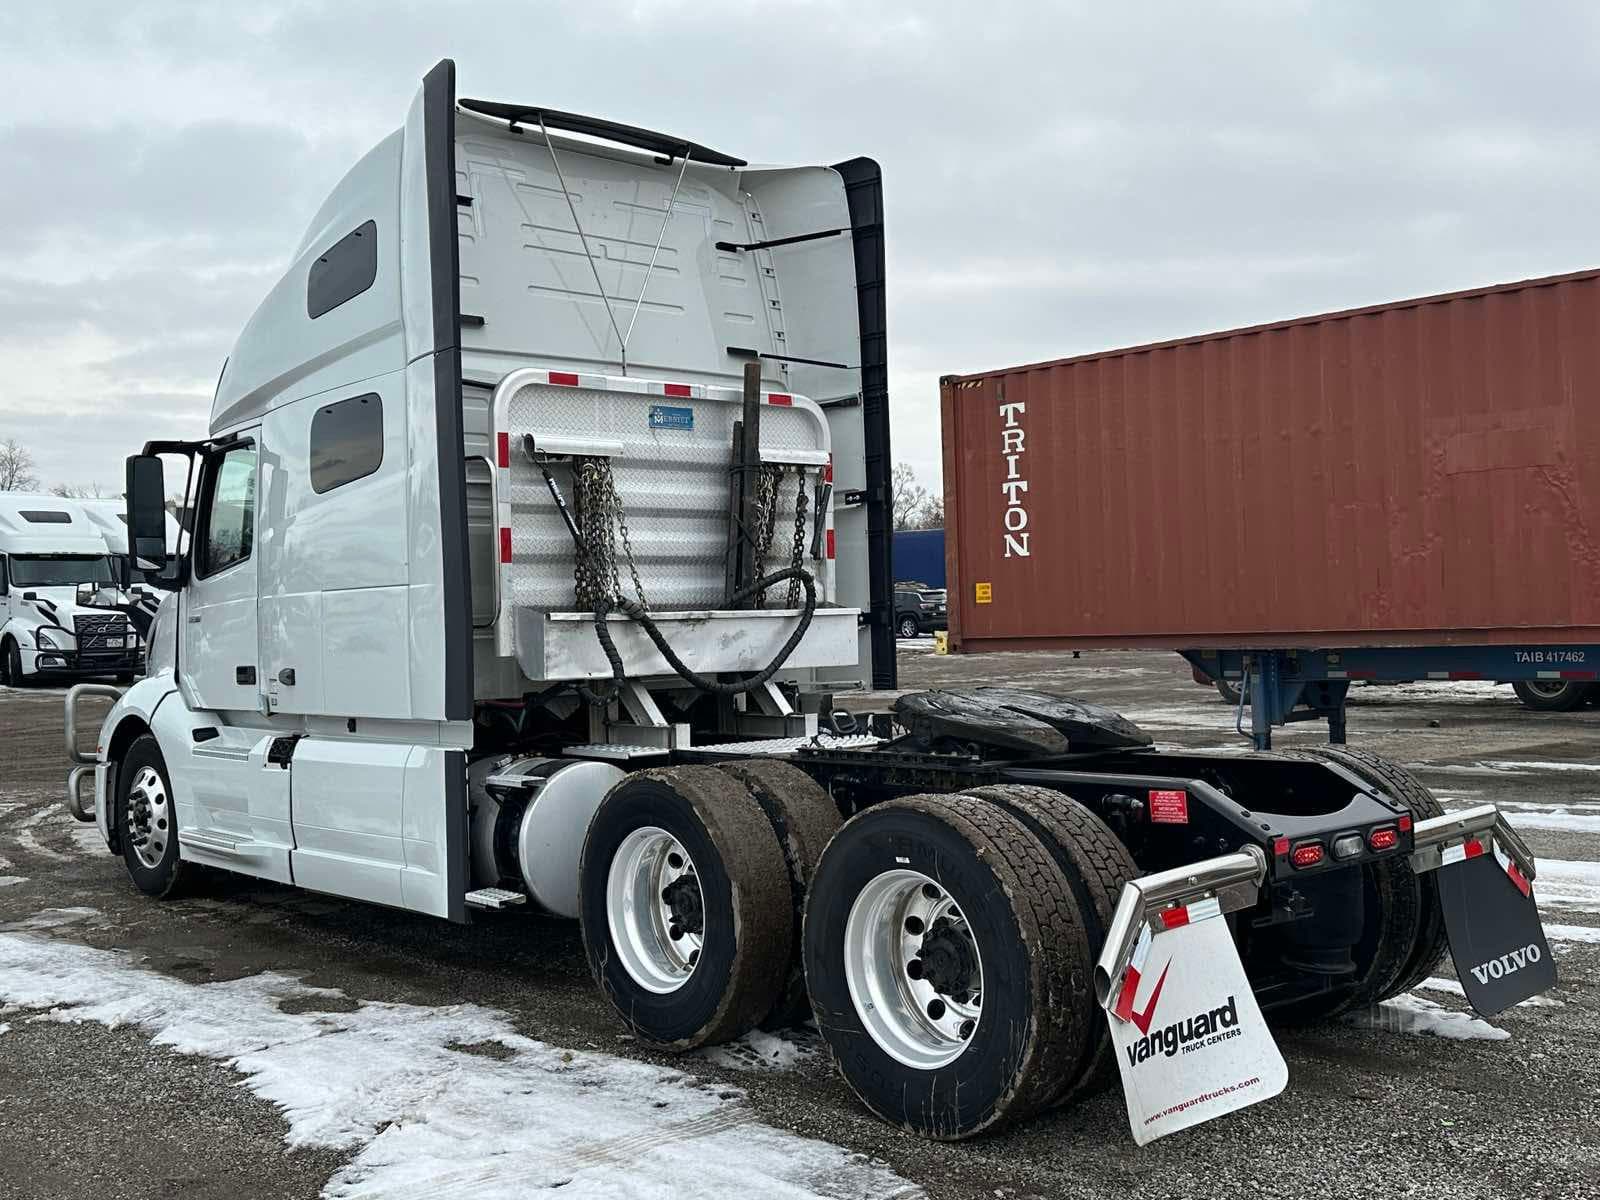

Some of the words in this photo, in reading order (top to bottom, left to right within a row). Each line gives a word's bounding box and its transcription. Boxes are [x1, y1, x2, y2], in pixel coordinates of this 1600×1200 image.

[999, 401, 1030, 558] TRITON
[1514, 651, 1544, 663] TAIB
[1546, 651, 1585, 663] 417462
[1470, 943, 1541, 985] VOLVO
[1126, 995, 1239, 1067] vanguard
[1181, 1040, 1206, 1055] TRUCK
[1207, 1028, 1242, 1046] CENTERS
[1143, 1076, 1260, 1126] www.vanguardtrucks.com
